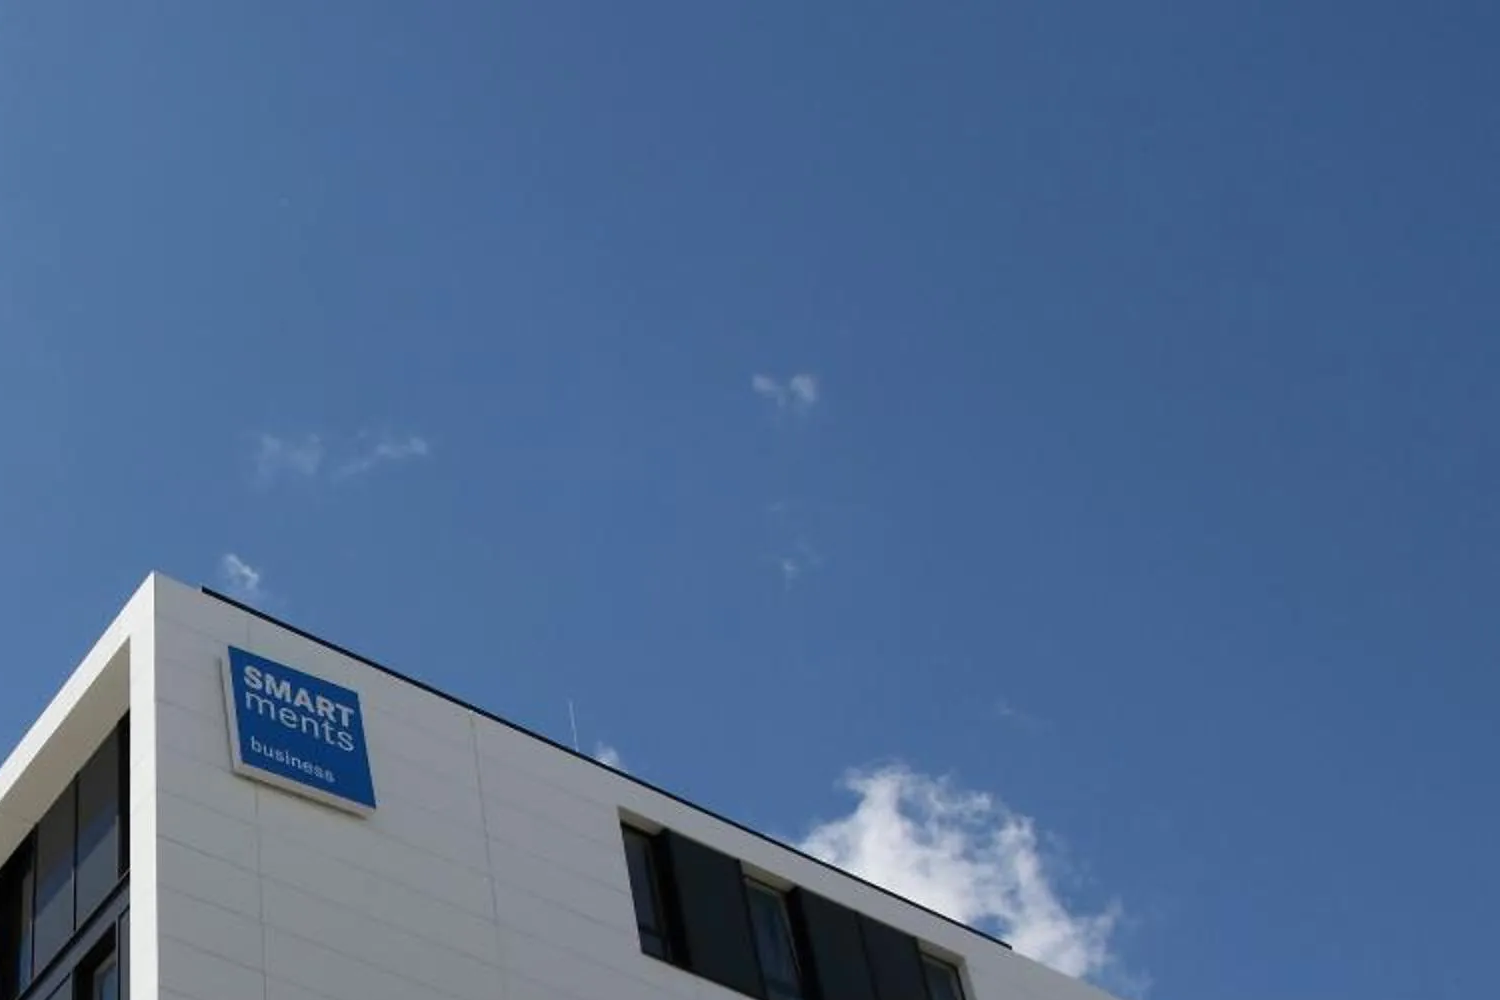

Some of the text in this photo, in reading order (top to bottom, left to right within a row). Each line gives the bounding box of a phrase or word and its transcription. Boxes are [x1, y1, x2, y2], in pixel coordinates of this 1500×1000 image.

[243, 665, 355, 728] SMART
[245, 691, 355, 752] ments
[250, 735, 336, 783] business
